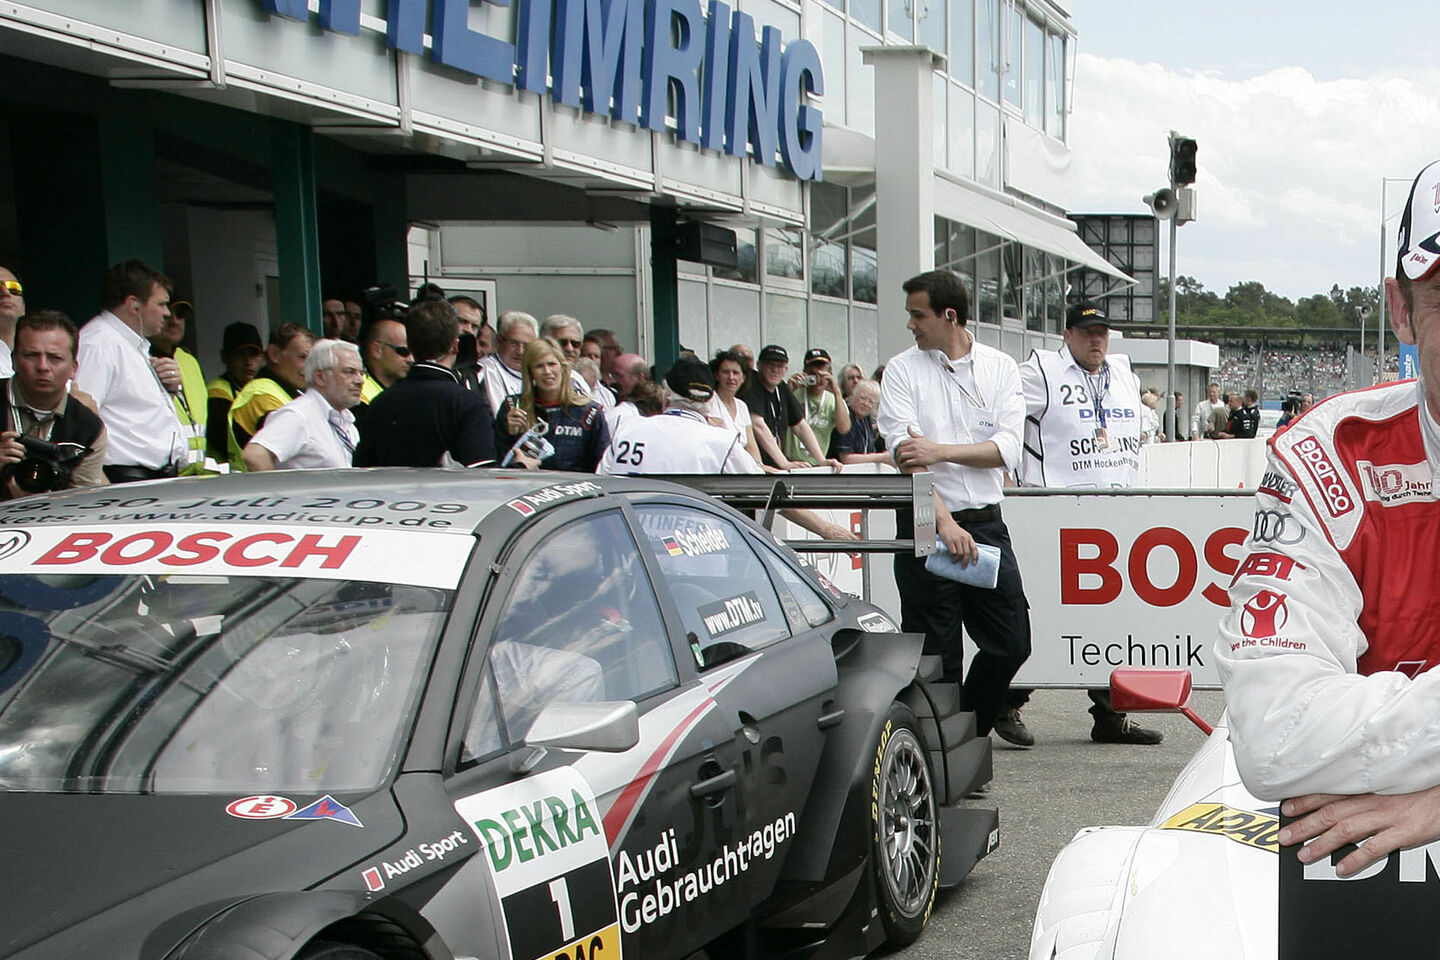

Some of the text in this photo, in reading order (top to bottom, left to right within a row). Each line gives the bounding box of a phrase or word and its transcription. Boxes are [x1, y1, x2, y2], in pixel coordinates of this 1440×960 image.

[1060, 384, 1088, 405] 23
[554, 425, 582, 437] DTM
[616, 440, 645, 466] 25
[1072, 460, 1092, 471] DTM
[1296, 438, 1351, 514] sparco
[1405, 480, 1432, 490] Jahr
[179, 497, 288, 509] Juli
[314, 497, 469, 514] 2009
[523, 481, 602, 506] Audi Sport
[98, 510, 453, 530] www.audicup.de
[31, 531, 362, 569] BOSCH
[674, 524, 730, 557] Scheider
[704, 596, 764, 635] www.DTM.tv
[1062, 635, 1204, 666] Technik
[1242, 637, 1256, 648] the
[1260, 638, 1306, 651] Children
[473, 787, 600, 874] DEKRA
[382, 830, 469, 879] Audi Sport
[618, 828, 680, 893] Audi
[548, 877, 577, 941] 1
